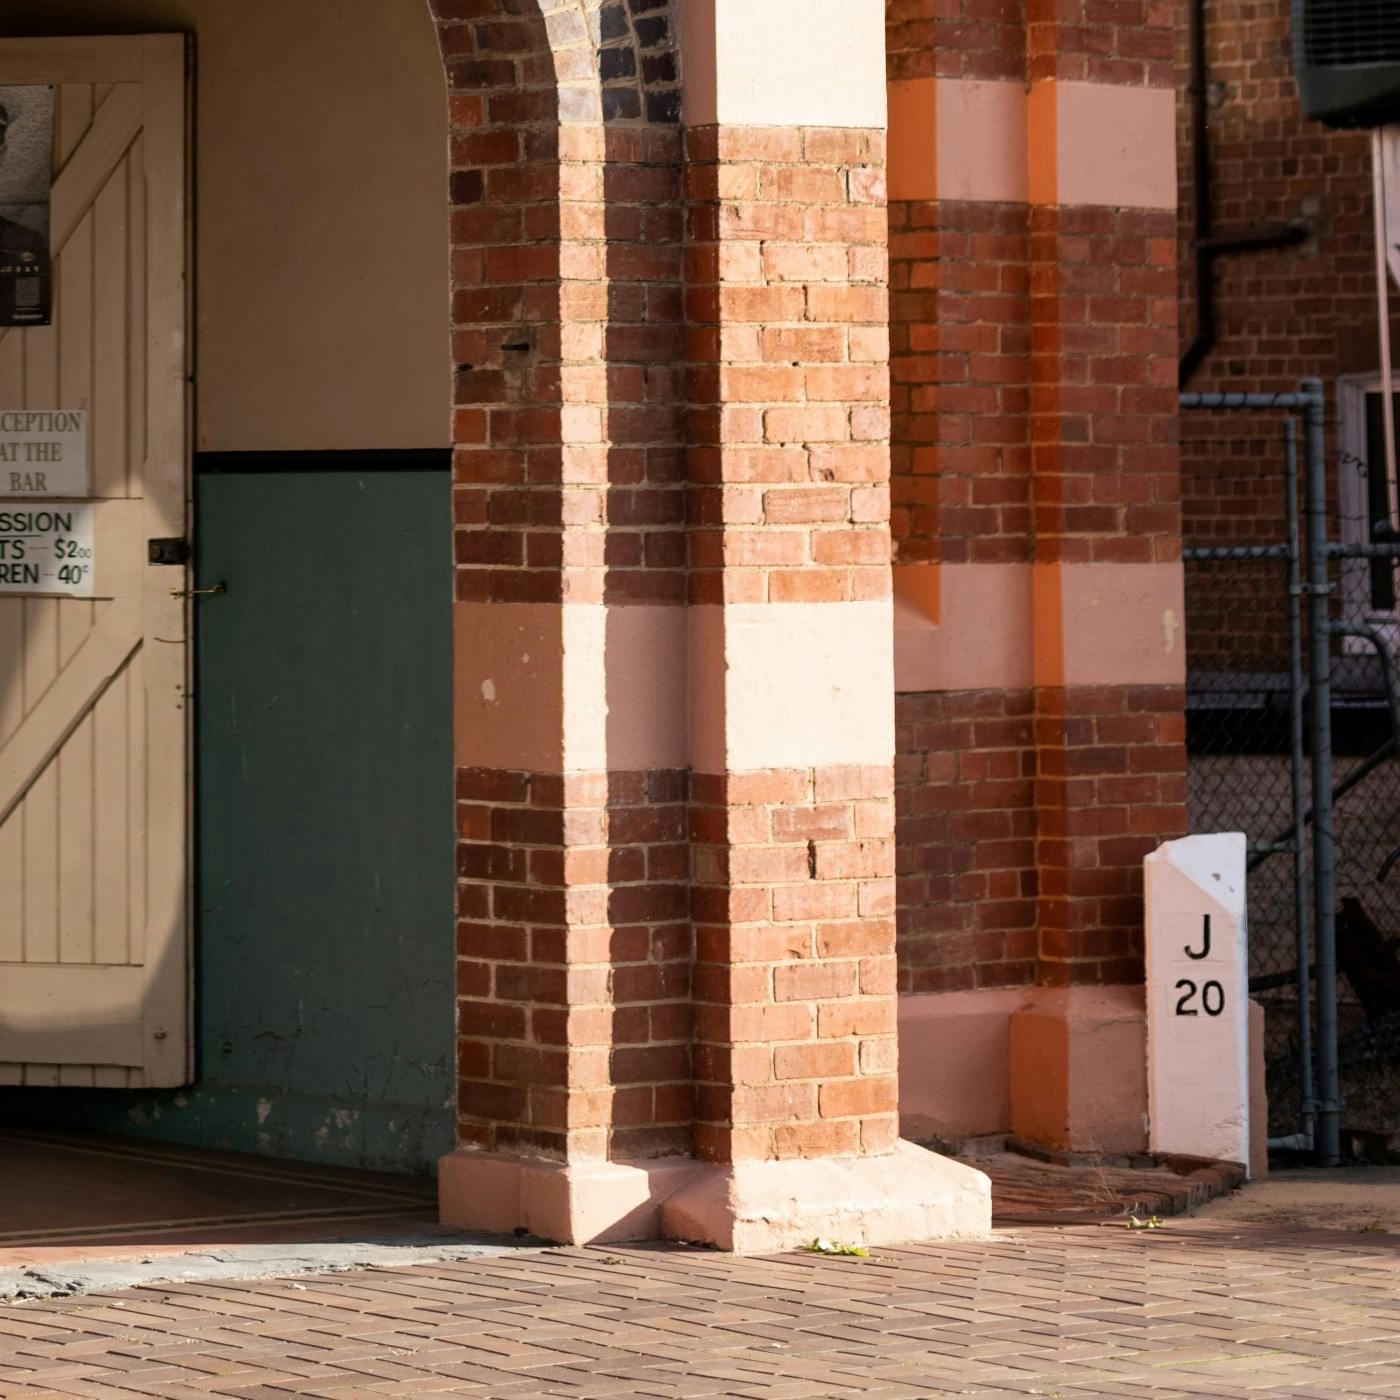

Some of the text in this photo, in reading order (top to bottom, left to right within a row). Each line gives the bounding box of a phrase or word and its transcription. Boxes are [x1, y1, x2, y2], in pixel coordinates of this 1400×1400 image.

[23, 442, 63, 462] THE
[10, 472, 48, 491] BAR
[1184, 913, 1212, 960] J
[1174, 978, 1226, 1017] 20
